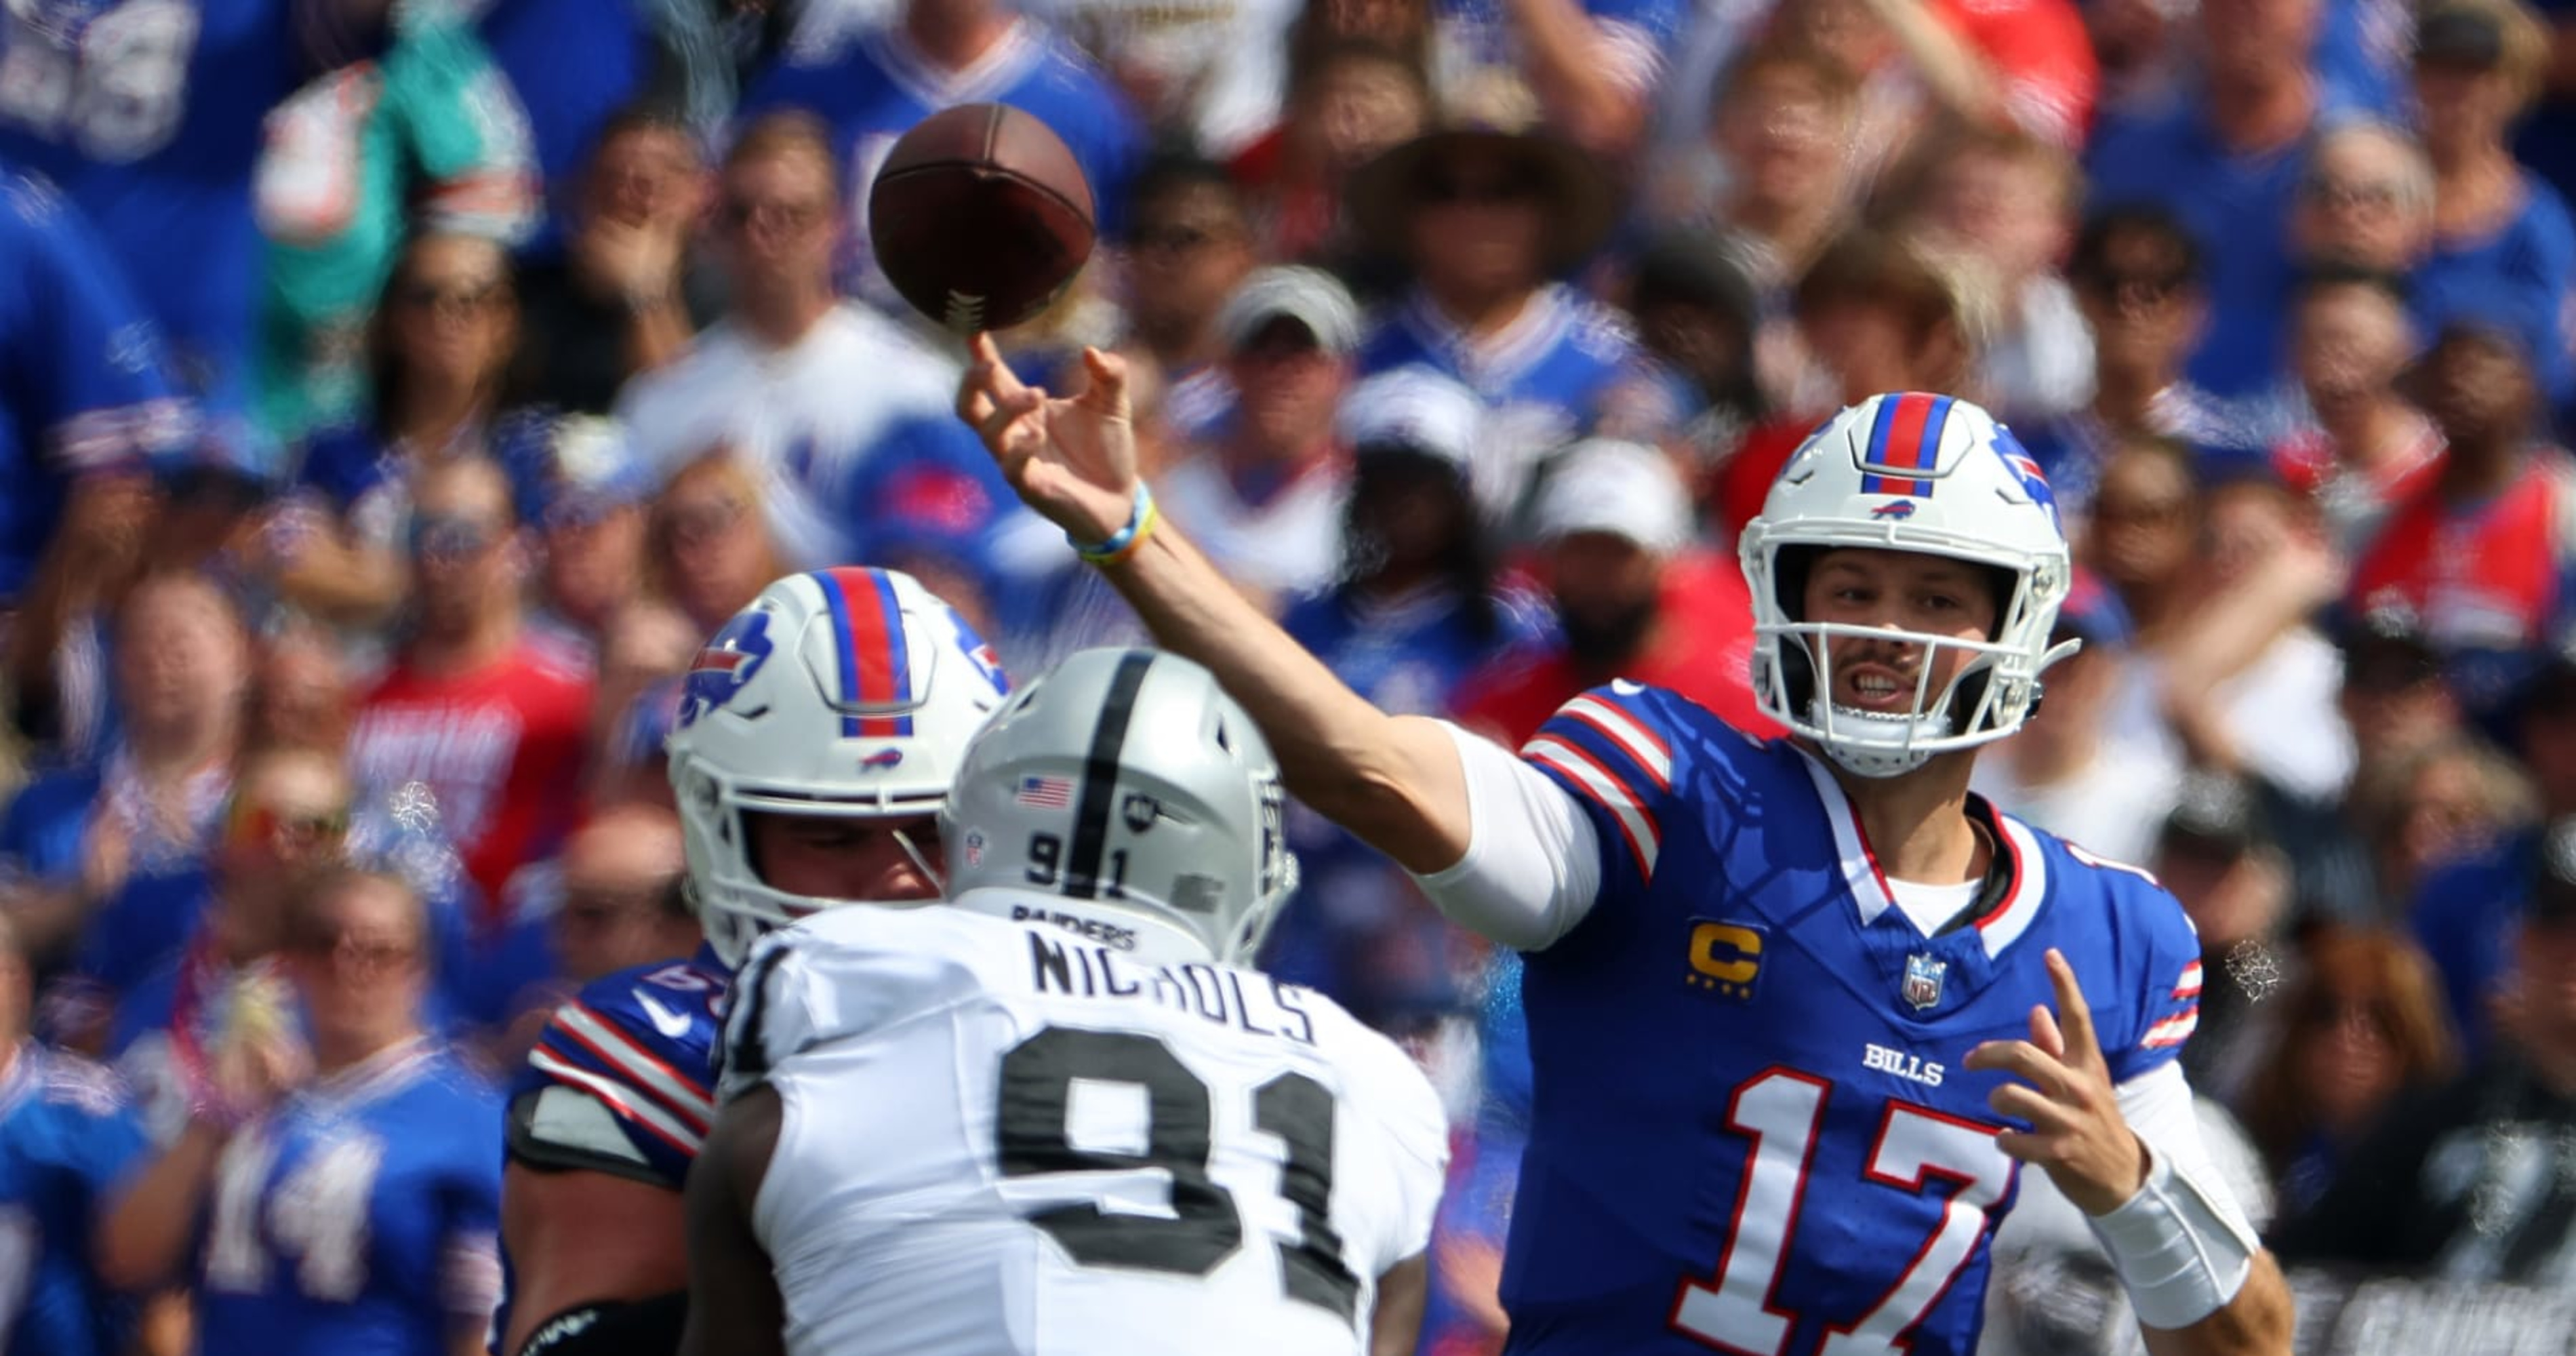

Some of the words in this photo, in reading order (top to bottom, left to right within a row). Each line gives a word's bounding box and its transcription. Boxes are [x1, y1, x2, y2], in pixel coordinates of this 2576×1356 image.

[1689, 923, 1761, 983] C
[1861, 1043, 1945, 1086] BILLS
[995, 1025, 1361, 1338] 91
[1665, 1063, 2018, 1356] 17
